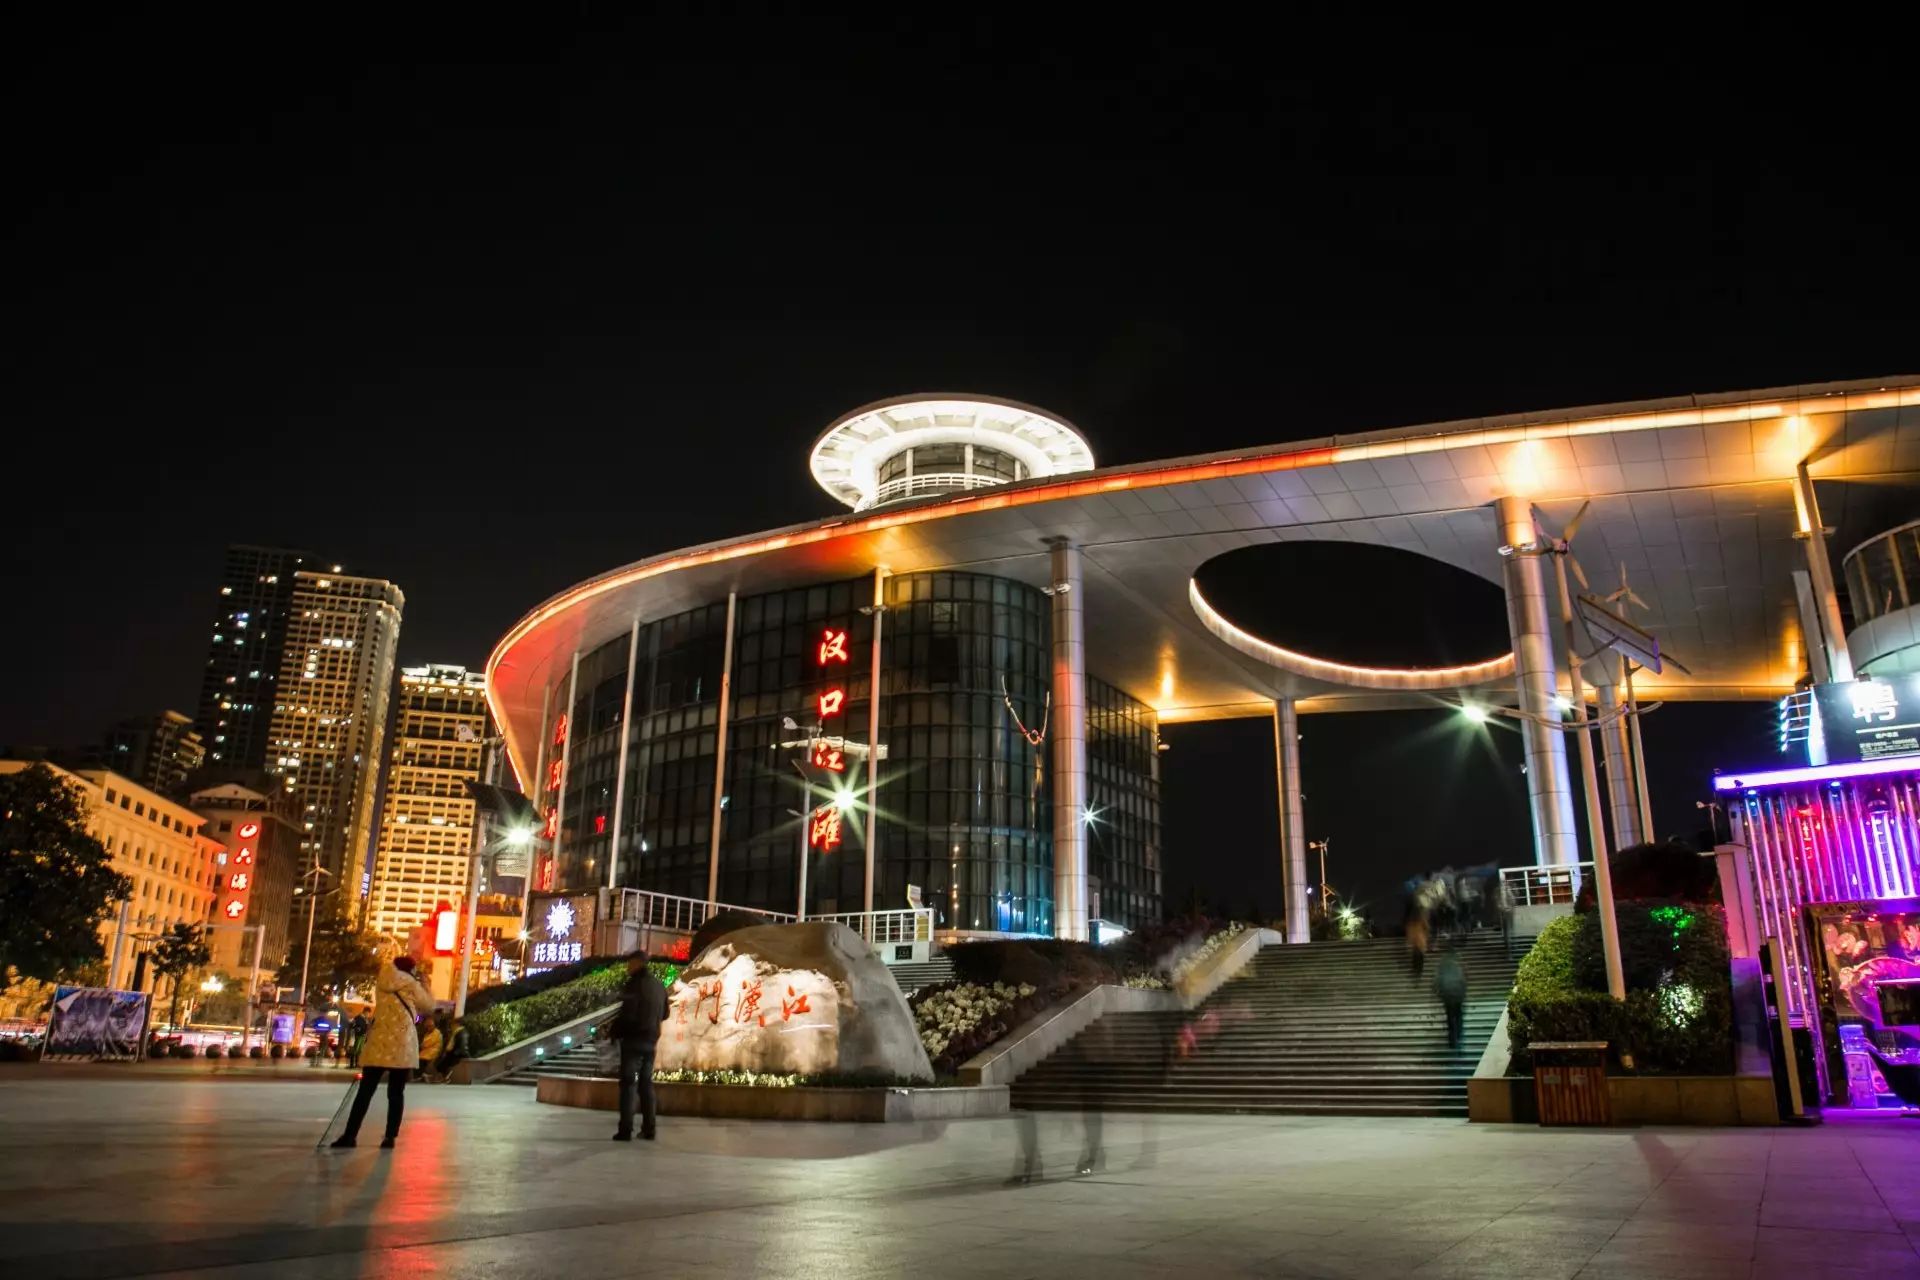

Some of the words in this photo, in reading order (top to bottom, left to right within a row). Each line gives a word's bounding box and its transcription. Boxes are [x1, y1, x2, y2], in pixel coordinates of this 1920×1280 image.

[811, 629, 848, 852] 汉口江滩
[533, 942, 583, 963] 托克拉克
